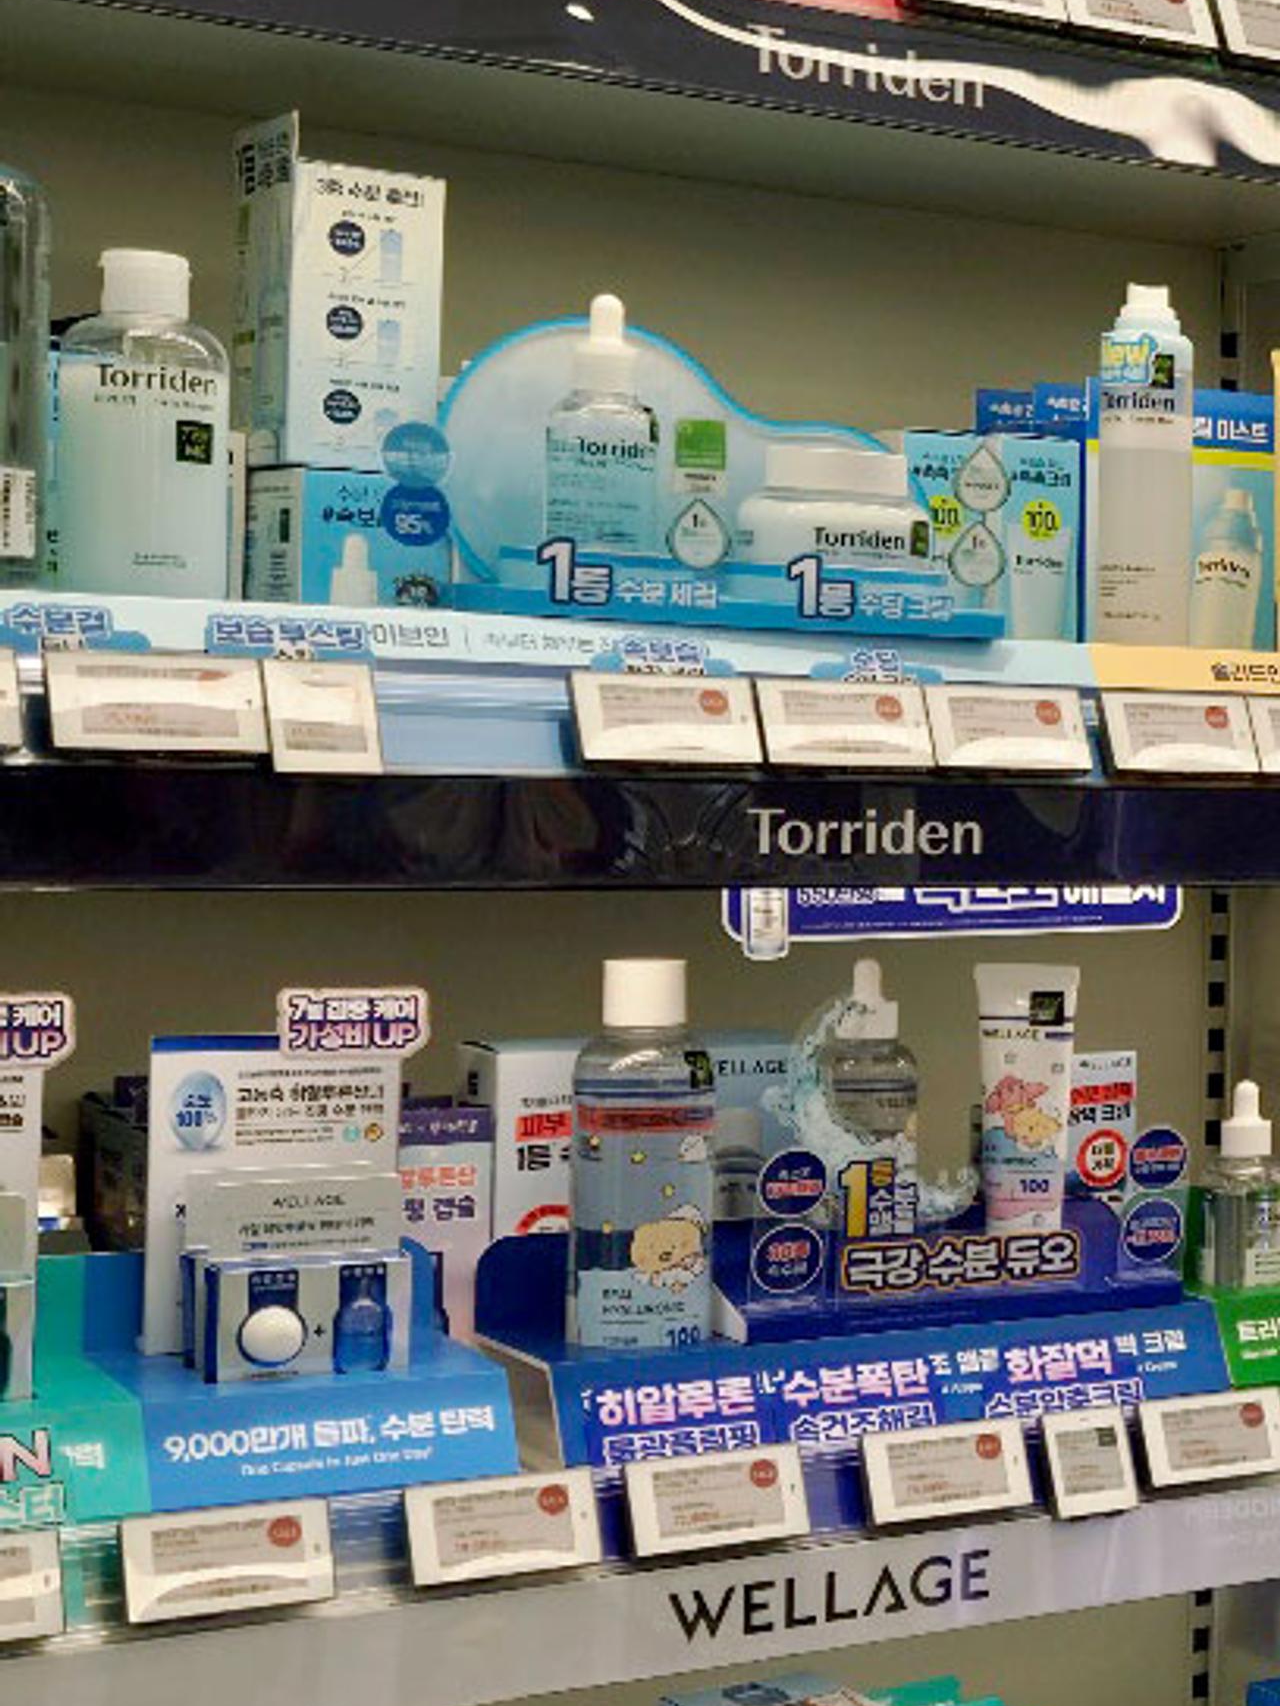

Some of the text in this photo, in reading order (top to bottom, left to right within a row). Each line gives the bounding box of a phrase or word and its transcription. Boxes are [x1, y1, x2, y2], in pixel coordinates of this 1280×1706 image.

[99, 363, 218, 396] Torriden
[537, 536, 613, 606] 1등
[787, 555, 855, 622] 1등
[370, 621, 449, 649] 이브인
[747, 807, 984, 857] Torriden
[15, 1028, 67, 1059] UP
[372, 1018, 421, 1048] UP
[718, 1059, 788, 1077] ELLAGE
[926, 1241, 997, 1282] 수분
[1001, 1233, 1078, 1276] 듀오
[783, 1357, 930, 1407] 수분폭탄
[668, 1547, 991, 1642] WELLAGE
